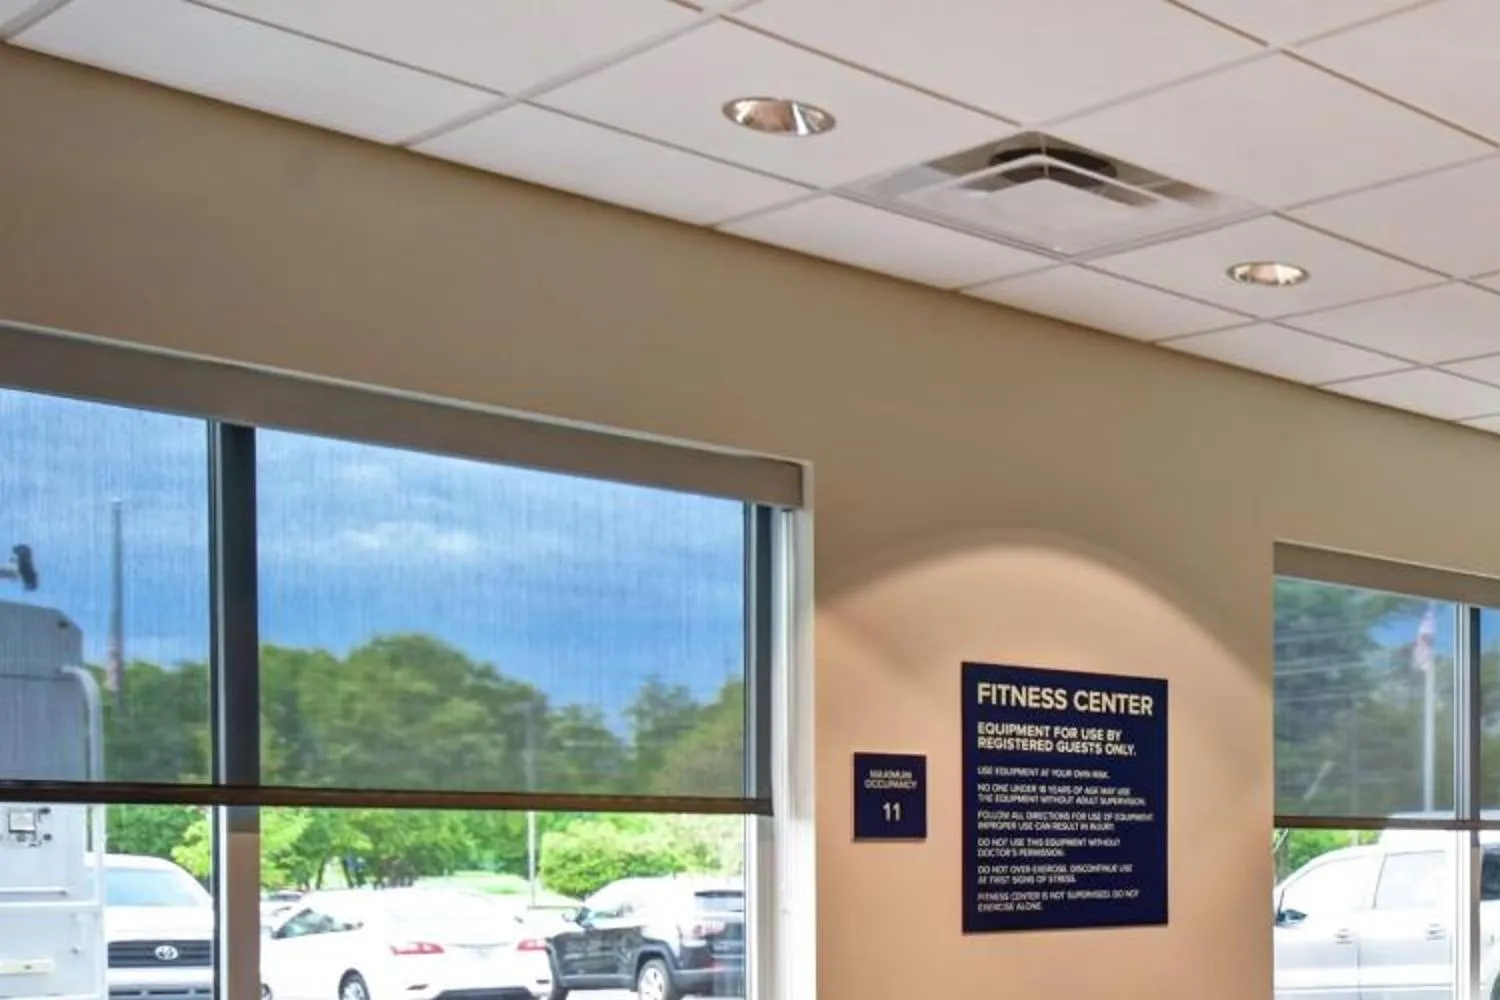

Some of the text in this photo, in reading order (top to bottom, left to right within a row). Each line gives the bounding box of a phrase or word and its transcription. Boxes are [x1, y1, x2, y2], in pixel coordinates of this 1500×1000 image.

[977, 682, 1154, 716] FITNESS CENTER
[977, 722, 1122, 742] EQUIPMENT FOR USE BY
[977, 736, 1136, 756] REGISTERED GUESTS ONLY.
[977, 784, 990, 793] NO
[882, 802, 900, 822] 11
[977, 838, 990, 846] DO
[977, 865, 990, 874] DO
